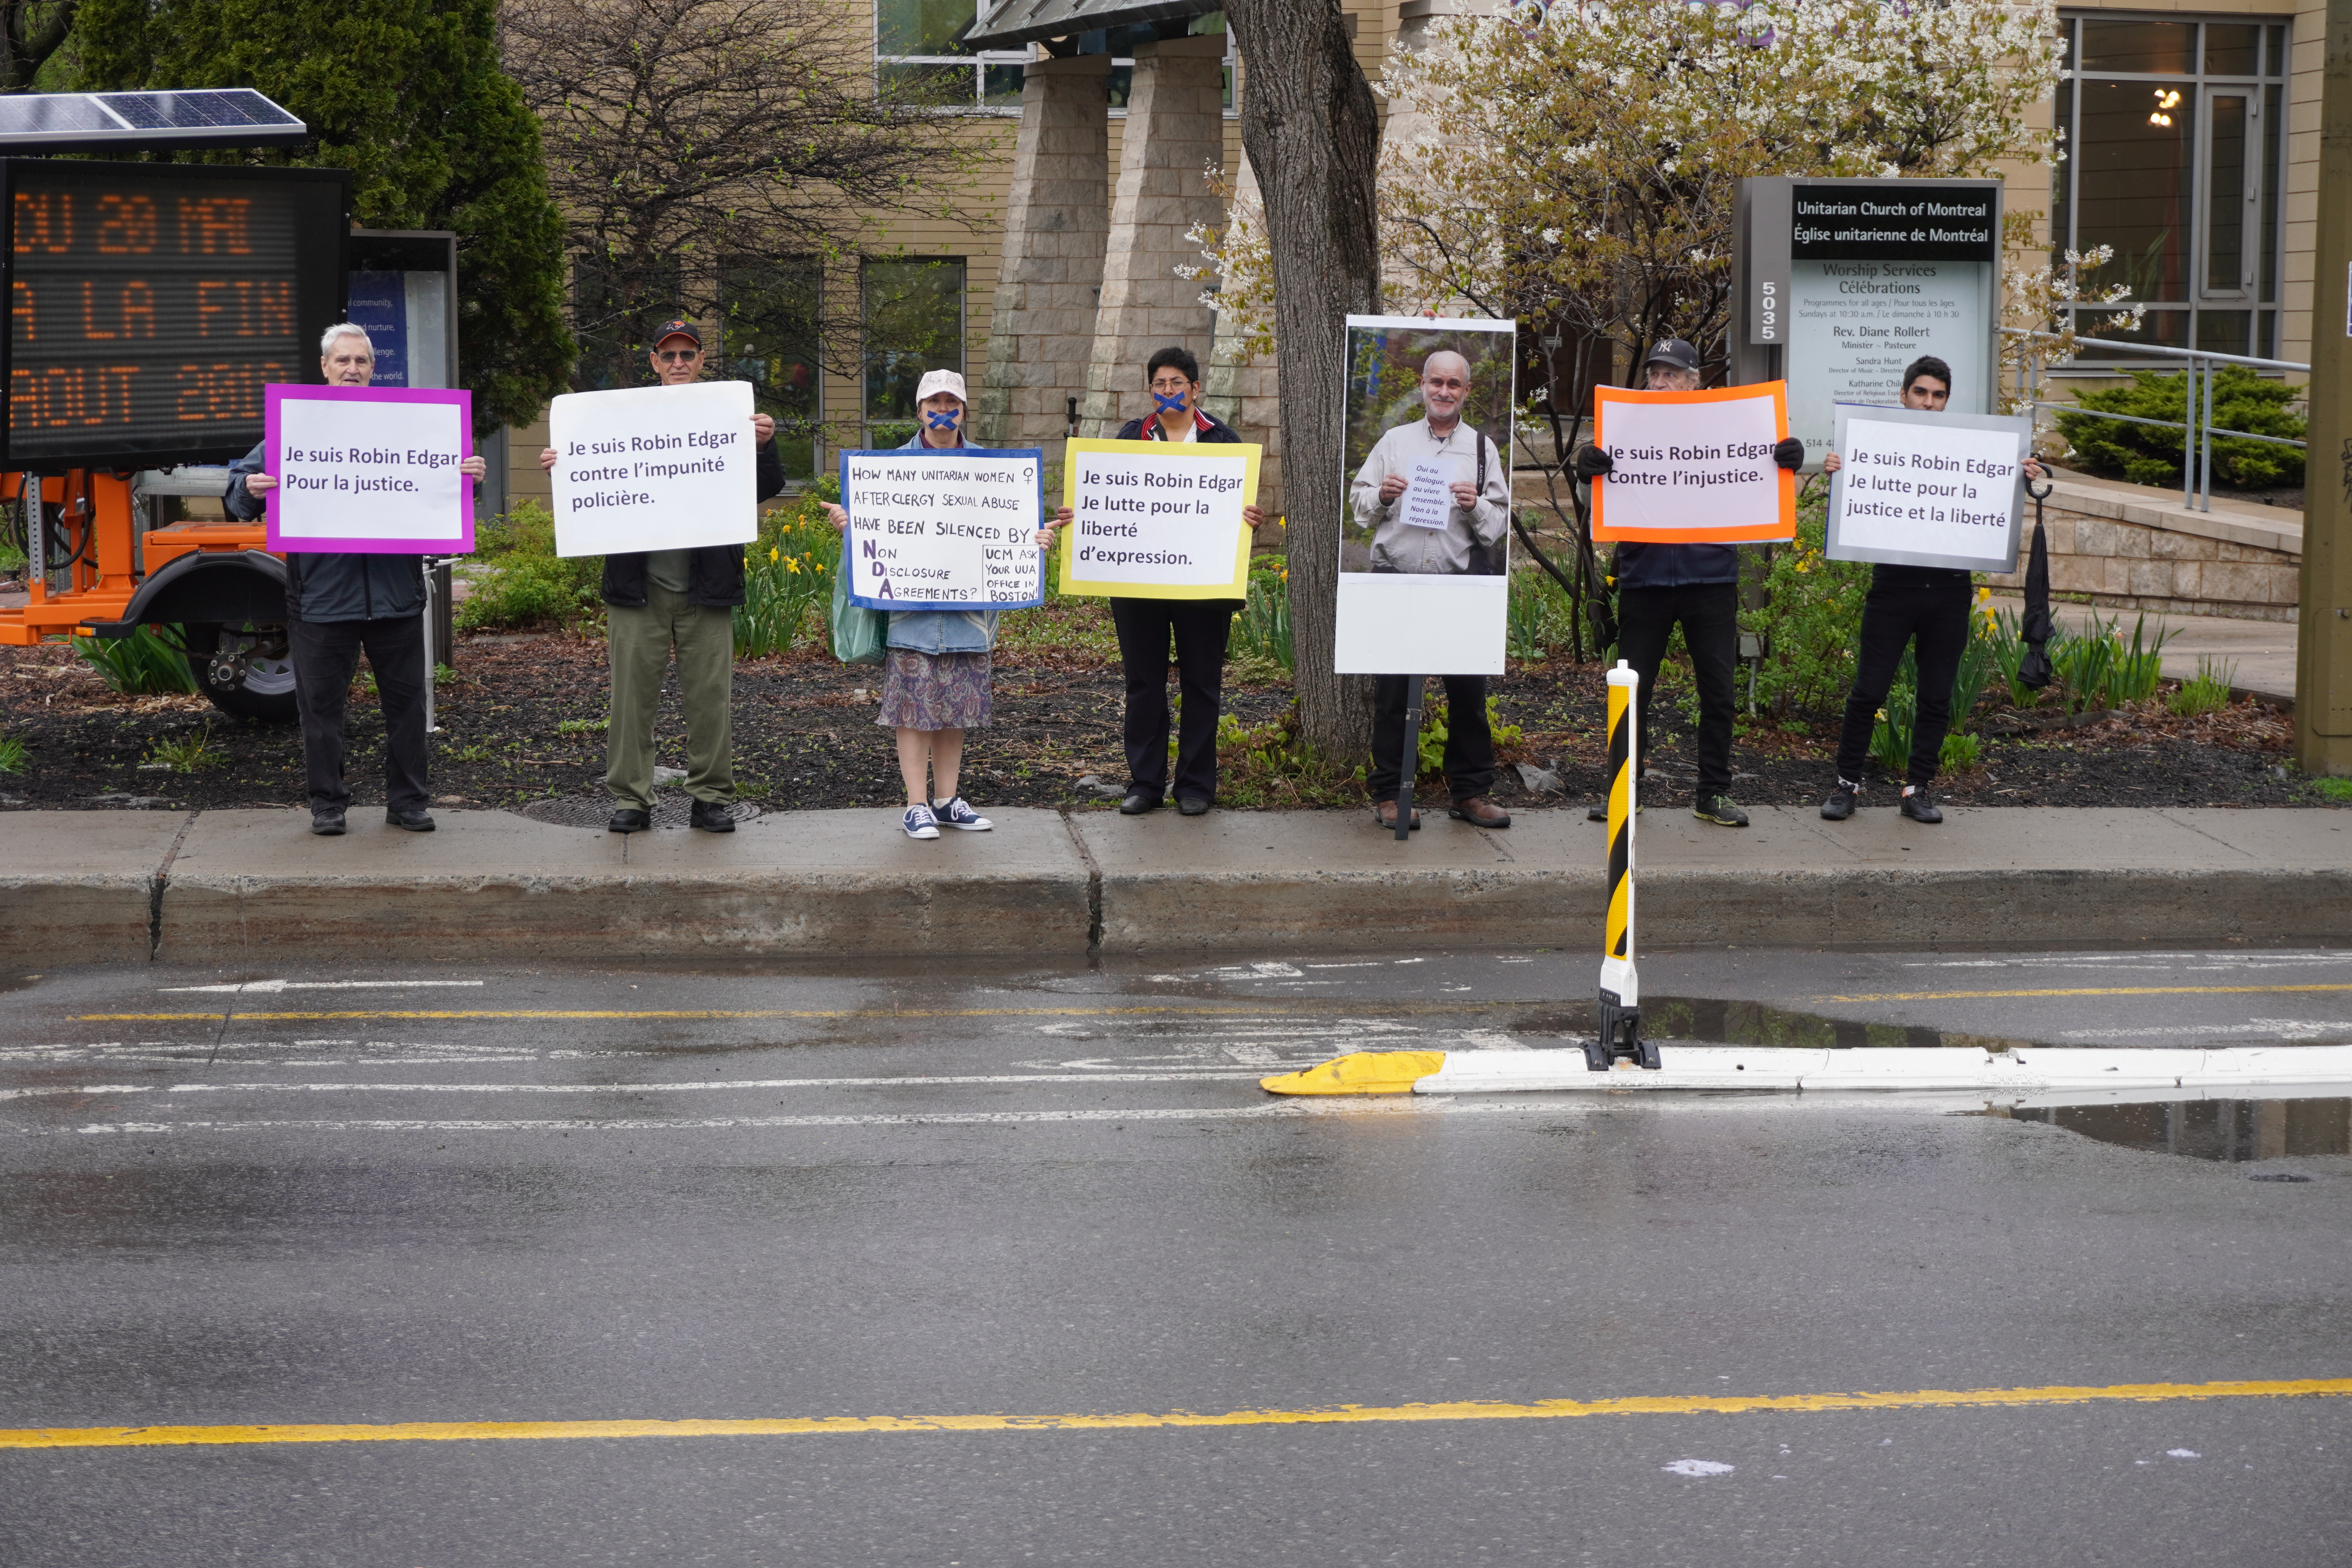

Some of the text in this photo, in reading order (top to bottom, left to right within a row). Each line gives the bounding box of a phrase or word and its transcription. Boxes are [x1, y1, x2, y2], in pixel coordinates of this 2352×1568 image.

[1798, 201, 1985, 216] Unitarian Church of Montreal
[14, 194, 73, 253] DU
[179, 198, 252, 254] MAI
[1795, 223, 1987, 244] Église unitarienne de Montréal
[1823, 264, 1936, 279] Worship Services
[1840, 280, 1920, 293] Célébrations
[83, 281, 154, 339] LA
[199, 281, 290, 336] FIN
[353, 299, 392, 308] community,
[1762, 282, 1775, 339] 5035
[1804, 299, 1846, 308] Programmes
[1940, 299, 1955, 308] âges
[1799, 310, 1827, 318] Sundays
[1834, 326, 1930, 336] Rev. Diane Rollert
[373, 347, 395, 357] llenge.
[1658, 340, 1672, 352] NY
[371, 371, 404, 380] the world.
[10, 366, 141, 428] AOUT
[568, 430, 737, 456] Je suis Robin Edgar
[1608, 442, 1775, 460] Je suis Robin Edgar
[286, 446, 458, 468] Je suis Robin Edgar
[1851, 448, 2014, 478] Je suis Robin Edgar
[570, 456, 724, 482] contre l'impunité
[853, 467, 1014, 483] HOW MANY UNITARIAN WOMEN
[1608, 469, 1763, 488] Contre l'injustice.
[287, 474, 419, 494] Pour la justice.
[1083, 470, 1243, 492] Je suis Robin Edgar
[1415, 475, 1445, 486] dialogue,
[1849, 474, 1976, 499] Je lutte pour la
[572, 490, 655, 512] policière.
[854, 491, 1019, 510] AFTER CLERGY SEXUAL ABUSE
[1082, 495, 1209, 515] Je lutte pour la
[1412, 497, 1445, 505] ensemble.
[1409, 515, 1445, 526] répression.
[1847, 499, 2005, 527] justice et la liberté
[854, 515, 1030, 543] HAVE BEEN SILENCED BY
[1082, 520, 1137, 537] liberté
[864, 539, 897, 559] NON
[986, 548, 1037, 560] UCM ASK
[1080, 546, 1192, 565] d'expression.
[872, 561, 951, 579] DISCLOSURE
[986, 564, 1036, 575] YOUR UUA
[878, 578, 977, 599] AGREEMENTS?
[990, 586, 1038, 602] BOSTON!
